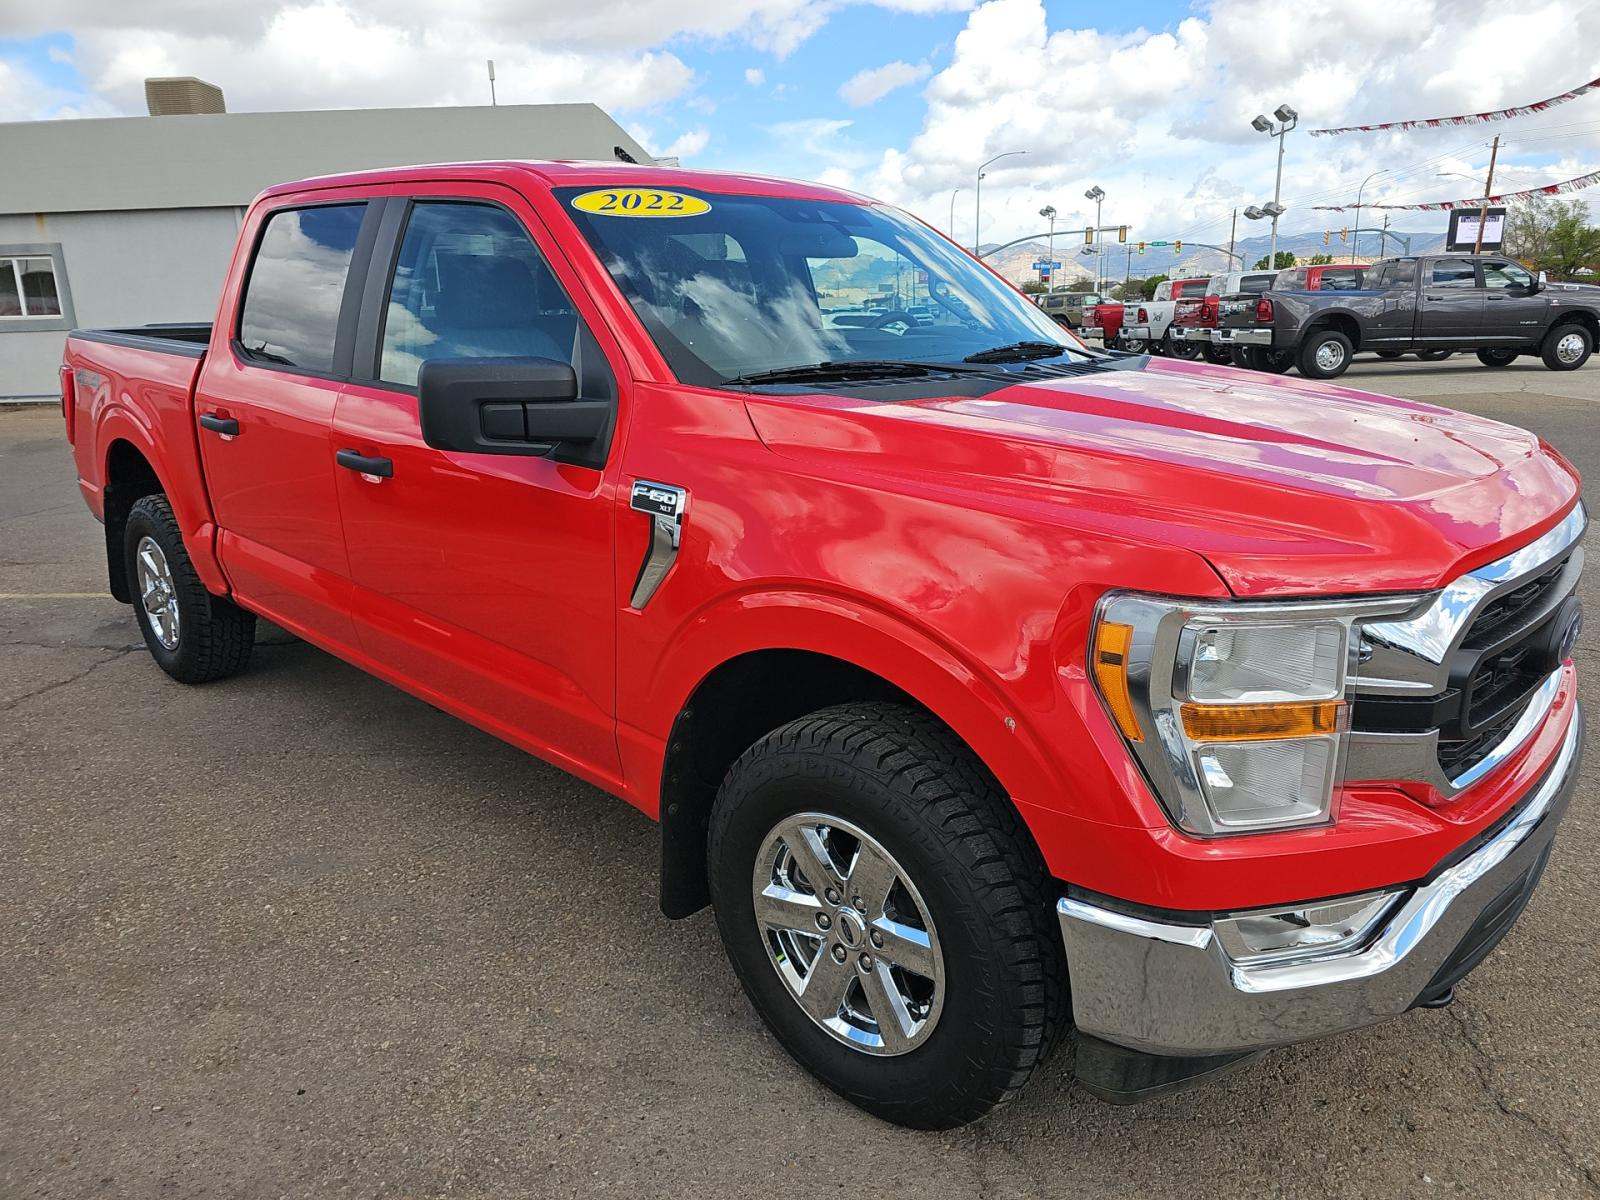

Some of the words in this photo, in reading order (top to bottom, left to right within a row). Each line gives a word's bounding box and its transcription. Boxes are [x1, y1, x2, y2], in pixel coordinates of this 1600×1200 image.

[598, 193, 684, 211] 2022
[633, 487, 676, 505] F-150
[660, 504, 672, 512] XLT
